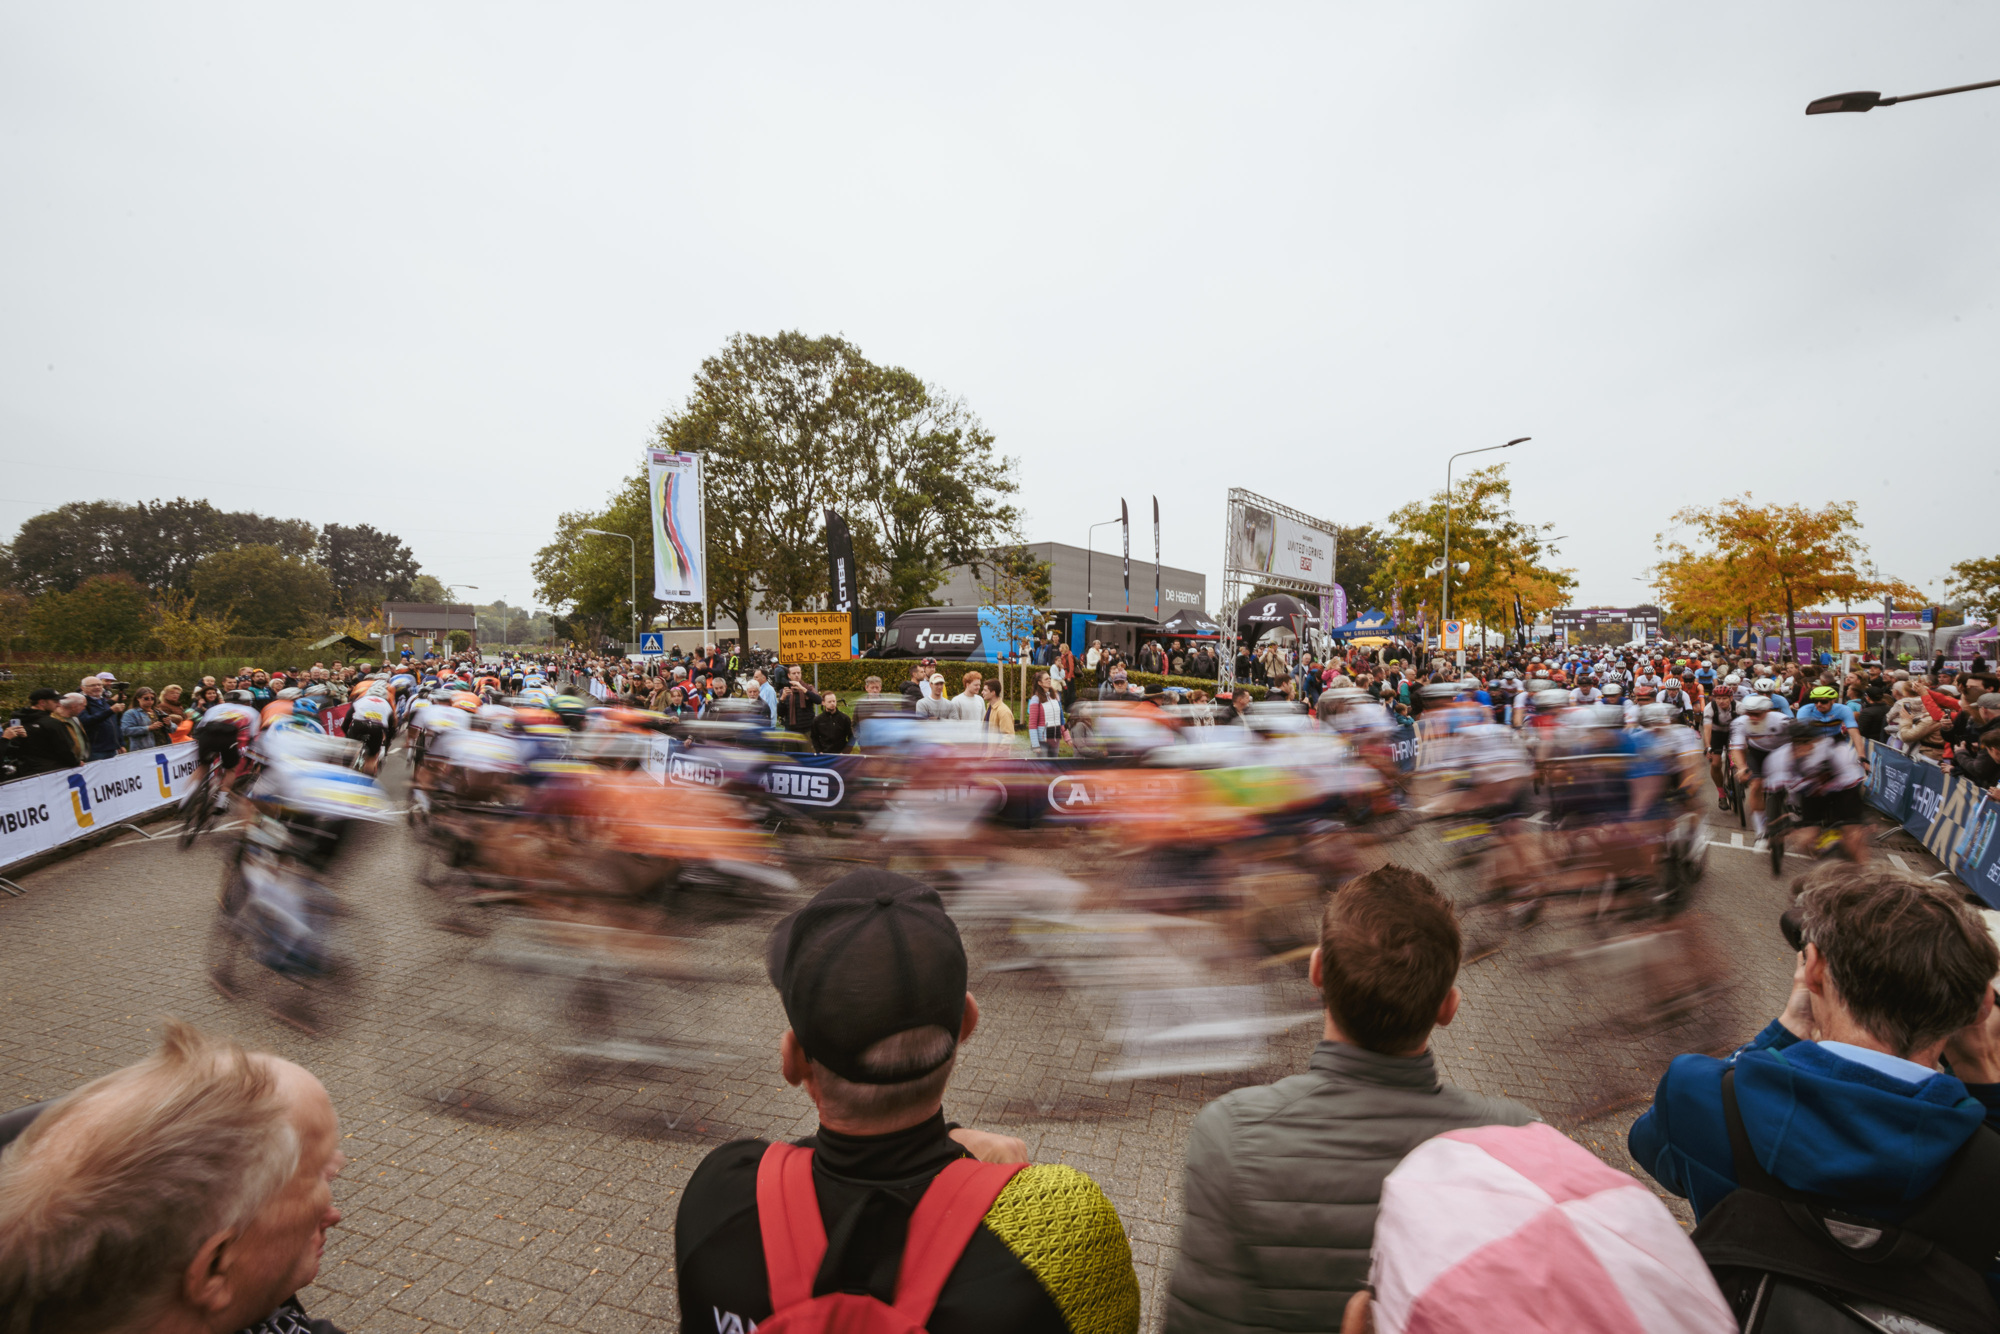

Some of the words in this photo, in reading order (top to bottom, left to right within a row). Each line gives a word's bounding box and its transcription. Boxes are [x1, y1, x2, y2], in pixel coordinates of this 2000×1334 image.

[782, 615, 801, 623] Deze
[803, 616, 818, 625] weg
[820, 615, 827, 623] is
[828, 615, 848, 623] dicht
[799, 628, 842, 636] evenement
[928, 633, 977, 645] CUBE
[782, 641, 797, 649] van
[782, 653, 794, 662] tot
[1389, 738, 1420, 763] THRIVE
[671, 759, 716, 786] ABUS
[93, 775, 143, 803] LIMBURG
[757, 771, 830, 799] ABUS
[1911, 783, 1944, 825] THRIVE
